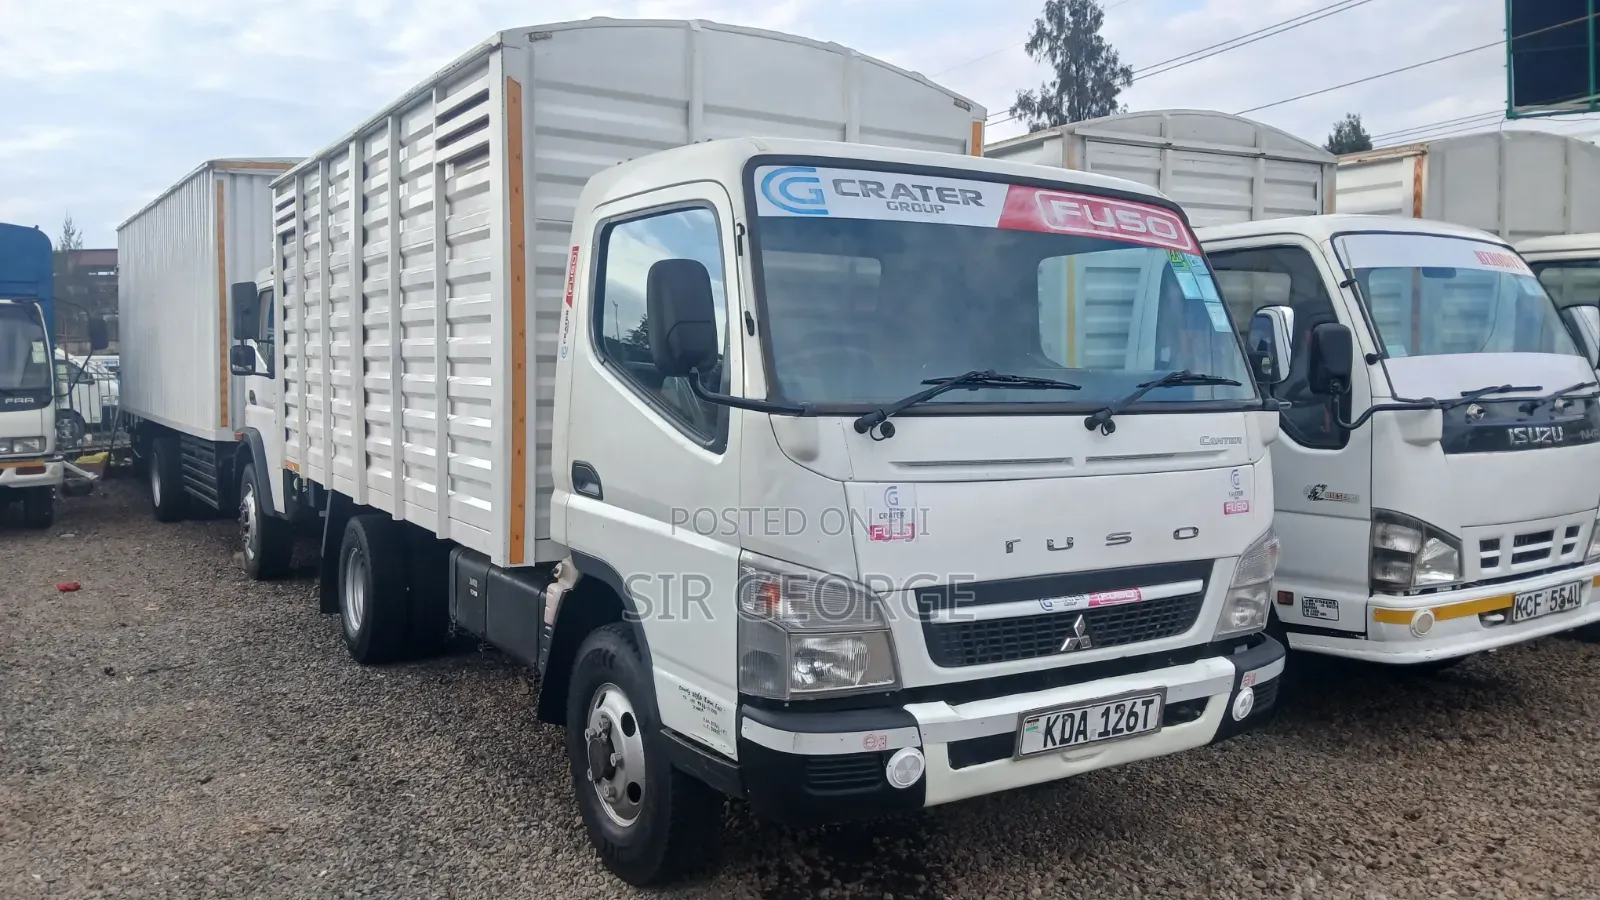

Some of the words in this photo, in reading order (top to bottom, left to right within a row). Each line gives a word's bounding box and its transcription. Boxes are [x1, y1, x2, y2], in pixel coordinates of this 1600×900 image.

[832, 178, 986, 207] CRATER
[1050, 200, 1178, 240] FUSO
[886, 200, 945, 214] GROUP
[567, 254, 578, 293] FUSO
[1508, 426, 1564, 445] ISUZU
[878, 511, 905, 520] CRATER
[1225, 501, 1248, 513] FUSO
[873, 525, 912, 538] FUO
[1515, 593, 1543, 620] KCF
[1549, 584, 1581, 612] 554U
[1043, 710, 1088, 749] KDA
[1098, 699, 1154, 738] 126T
